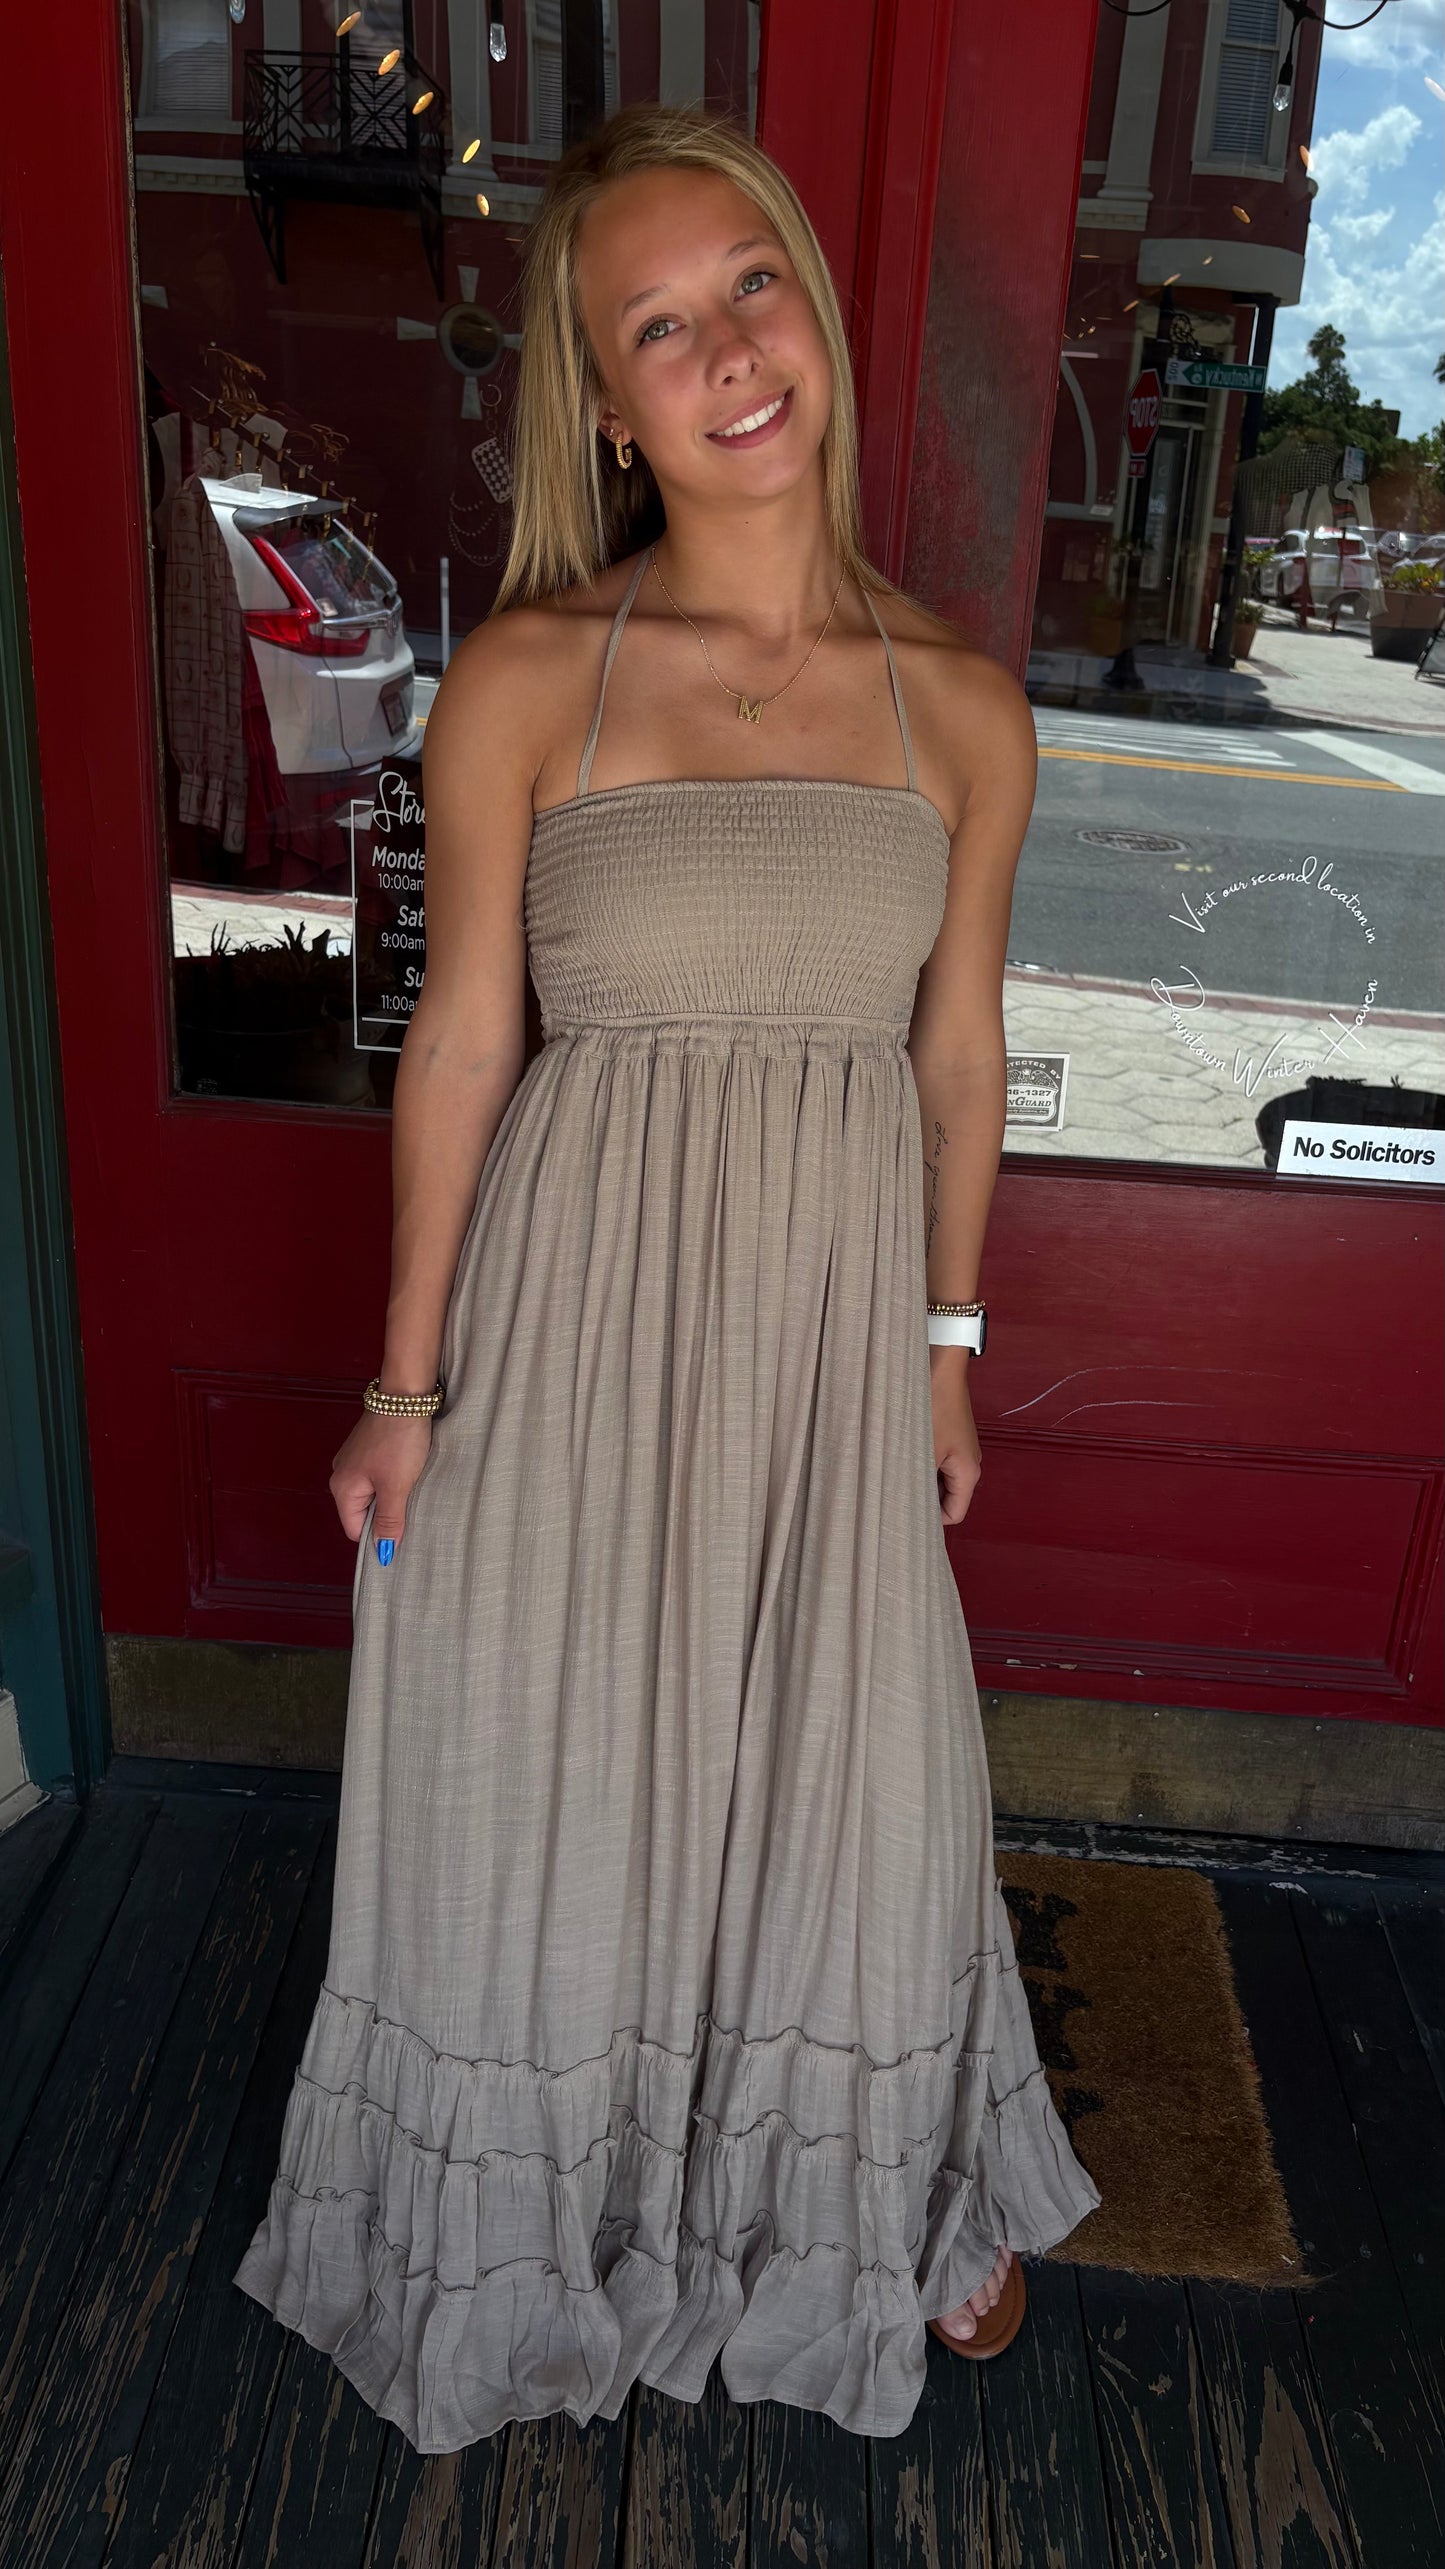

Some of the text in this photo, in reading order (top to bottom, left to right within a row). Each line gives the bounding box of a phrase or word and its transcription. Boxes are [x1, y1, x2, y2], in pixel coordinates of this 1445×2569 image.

[1168, 856, 1376, 944] Visit our second location in
[397, 904, 426, 928] Sat
[381, 932, 425, 950] 9:00am
[381, 994, 418, 1012] 11:00a
[1150, 965, 1378, 1098] Downtown Winter Haven
[1050, 1069, 1061, 1079] BY
[1293, 1136, 1436, 1166] No Solicitors
